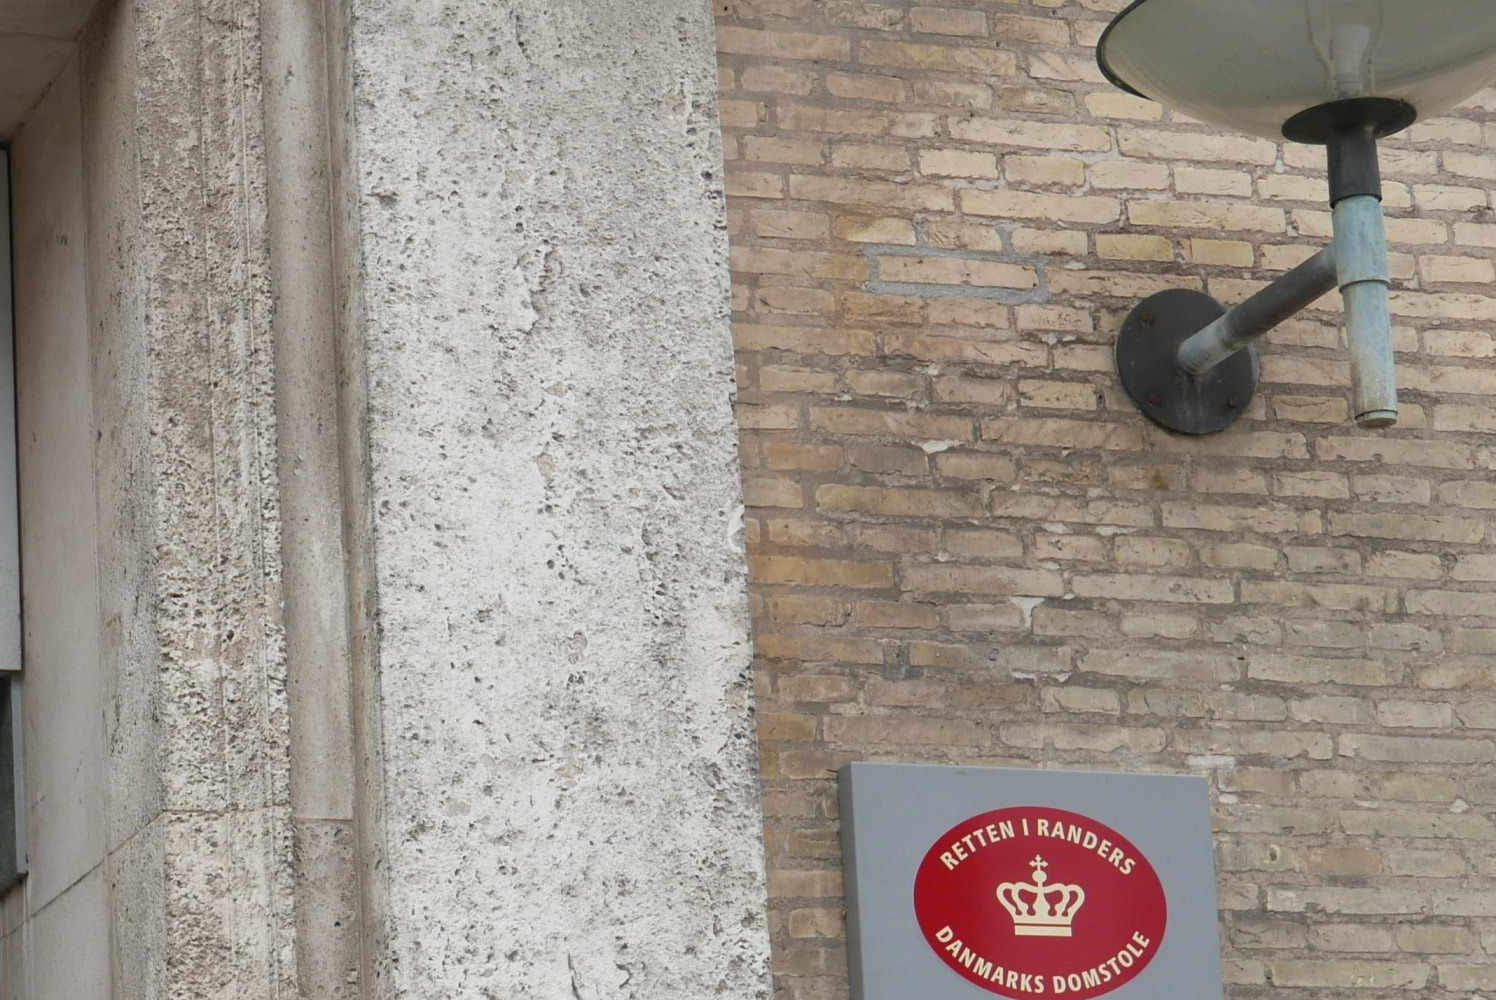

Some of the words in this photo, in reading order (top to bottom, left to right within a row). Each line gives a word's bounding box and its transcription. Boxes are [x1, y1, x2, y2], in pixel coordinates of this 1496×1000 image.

[940, 820, 1015, 871] RETTEN
[1021, 818, 1029, 836] I
[1037, 819, 1136, 875] RANDERS
[935, 925, 1044, 994] DANMARKS
[1053, 930, 1150, 994] DOMSTOLE
